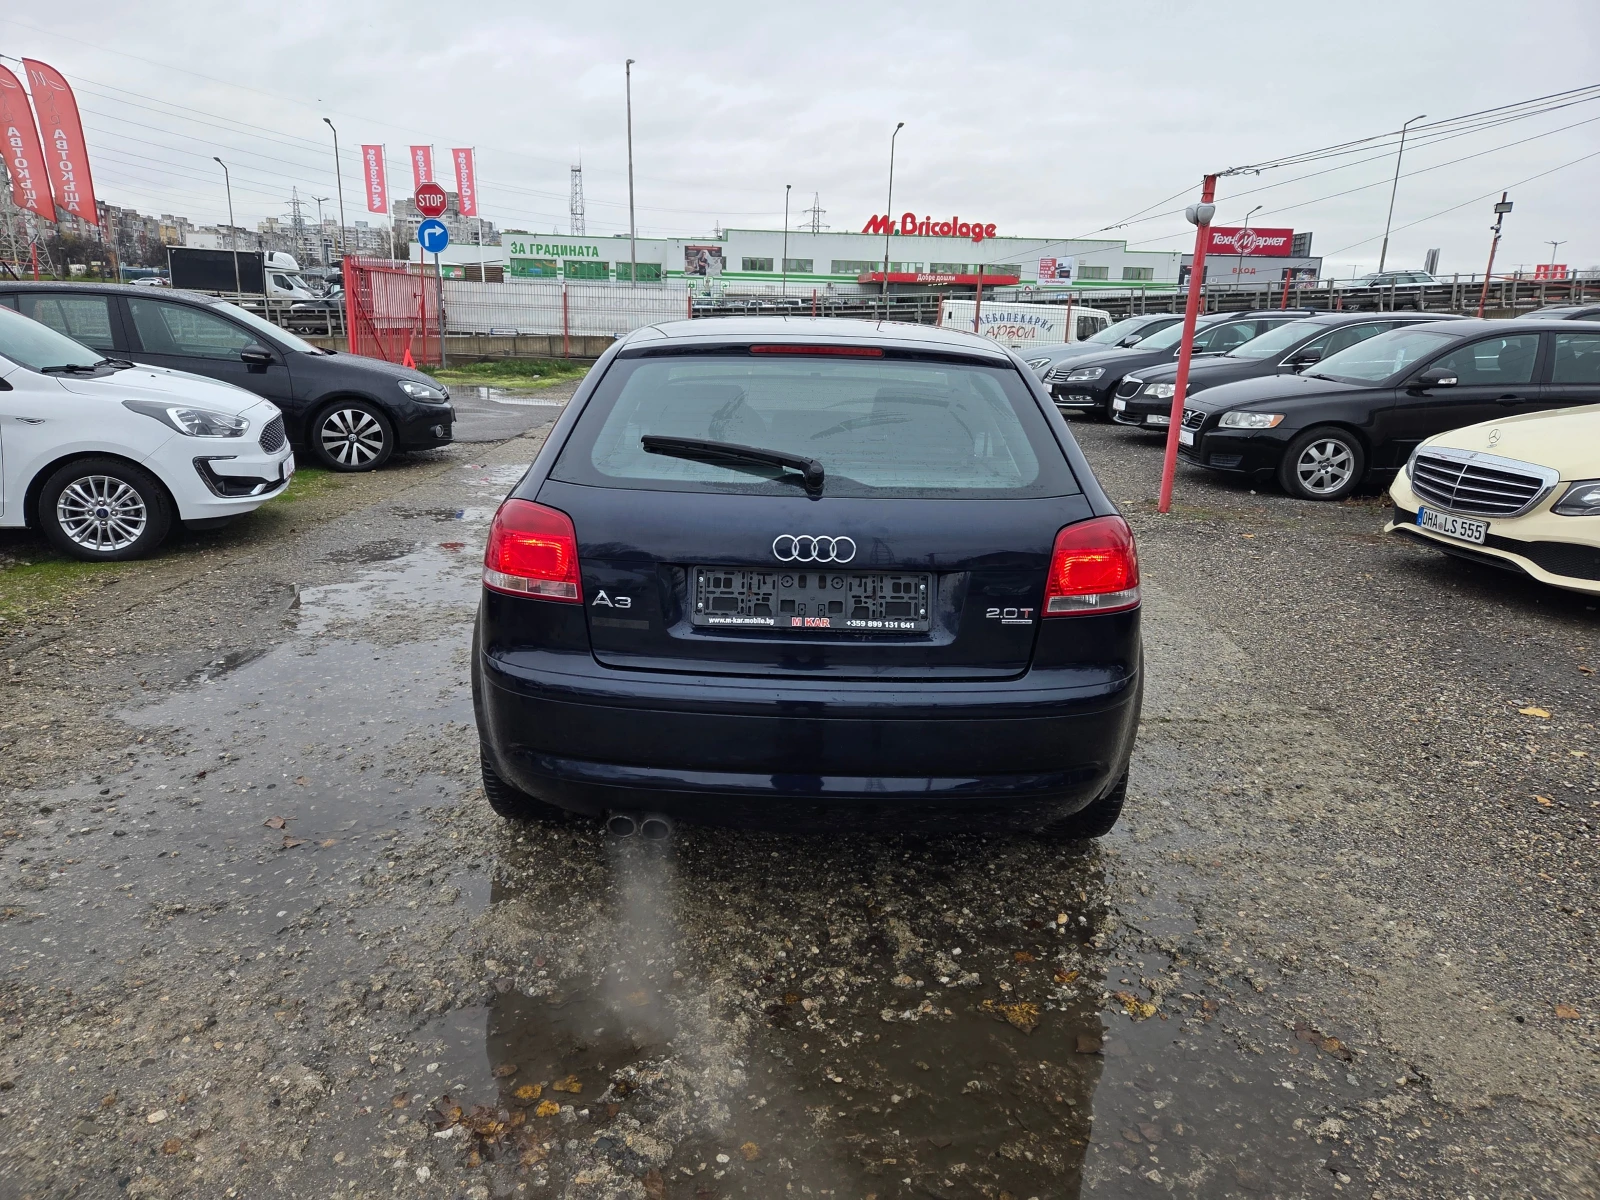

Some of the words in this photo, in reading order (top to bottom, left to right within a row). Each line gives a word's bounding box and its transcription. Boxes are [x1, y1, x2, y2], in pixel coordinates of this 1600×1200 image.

[418, 194, 444, 207] STOP
[510, 242, 526, 255] ЗА
[529, 243, 600, 258] ГРАДИНАТА
[1232, 267, 1256, 275] ВХОД
[916, 273, 936, 282] Добре
[936, 274, 956, 282] дошли
[1422, 511, 1438, 530] OHA
[1443, 517, 1458, 534] LS
[1460, 521, 1483, 540] 555
[591, 589, 632, 609] A3
[708, 617, 775, 626] www.m-kar.mobile.bg
[791, 617, 803, 627] M
[804, 617, 831, 628] KAR
[846, 619, 866, 628] +359
[867, 620, 883, 628] 899
[884, 620, 899, 629] 131
[900, 621, 915, 629] 641
